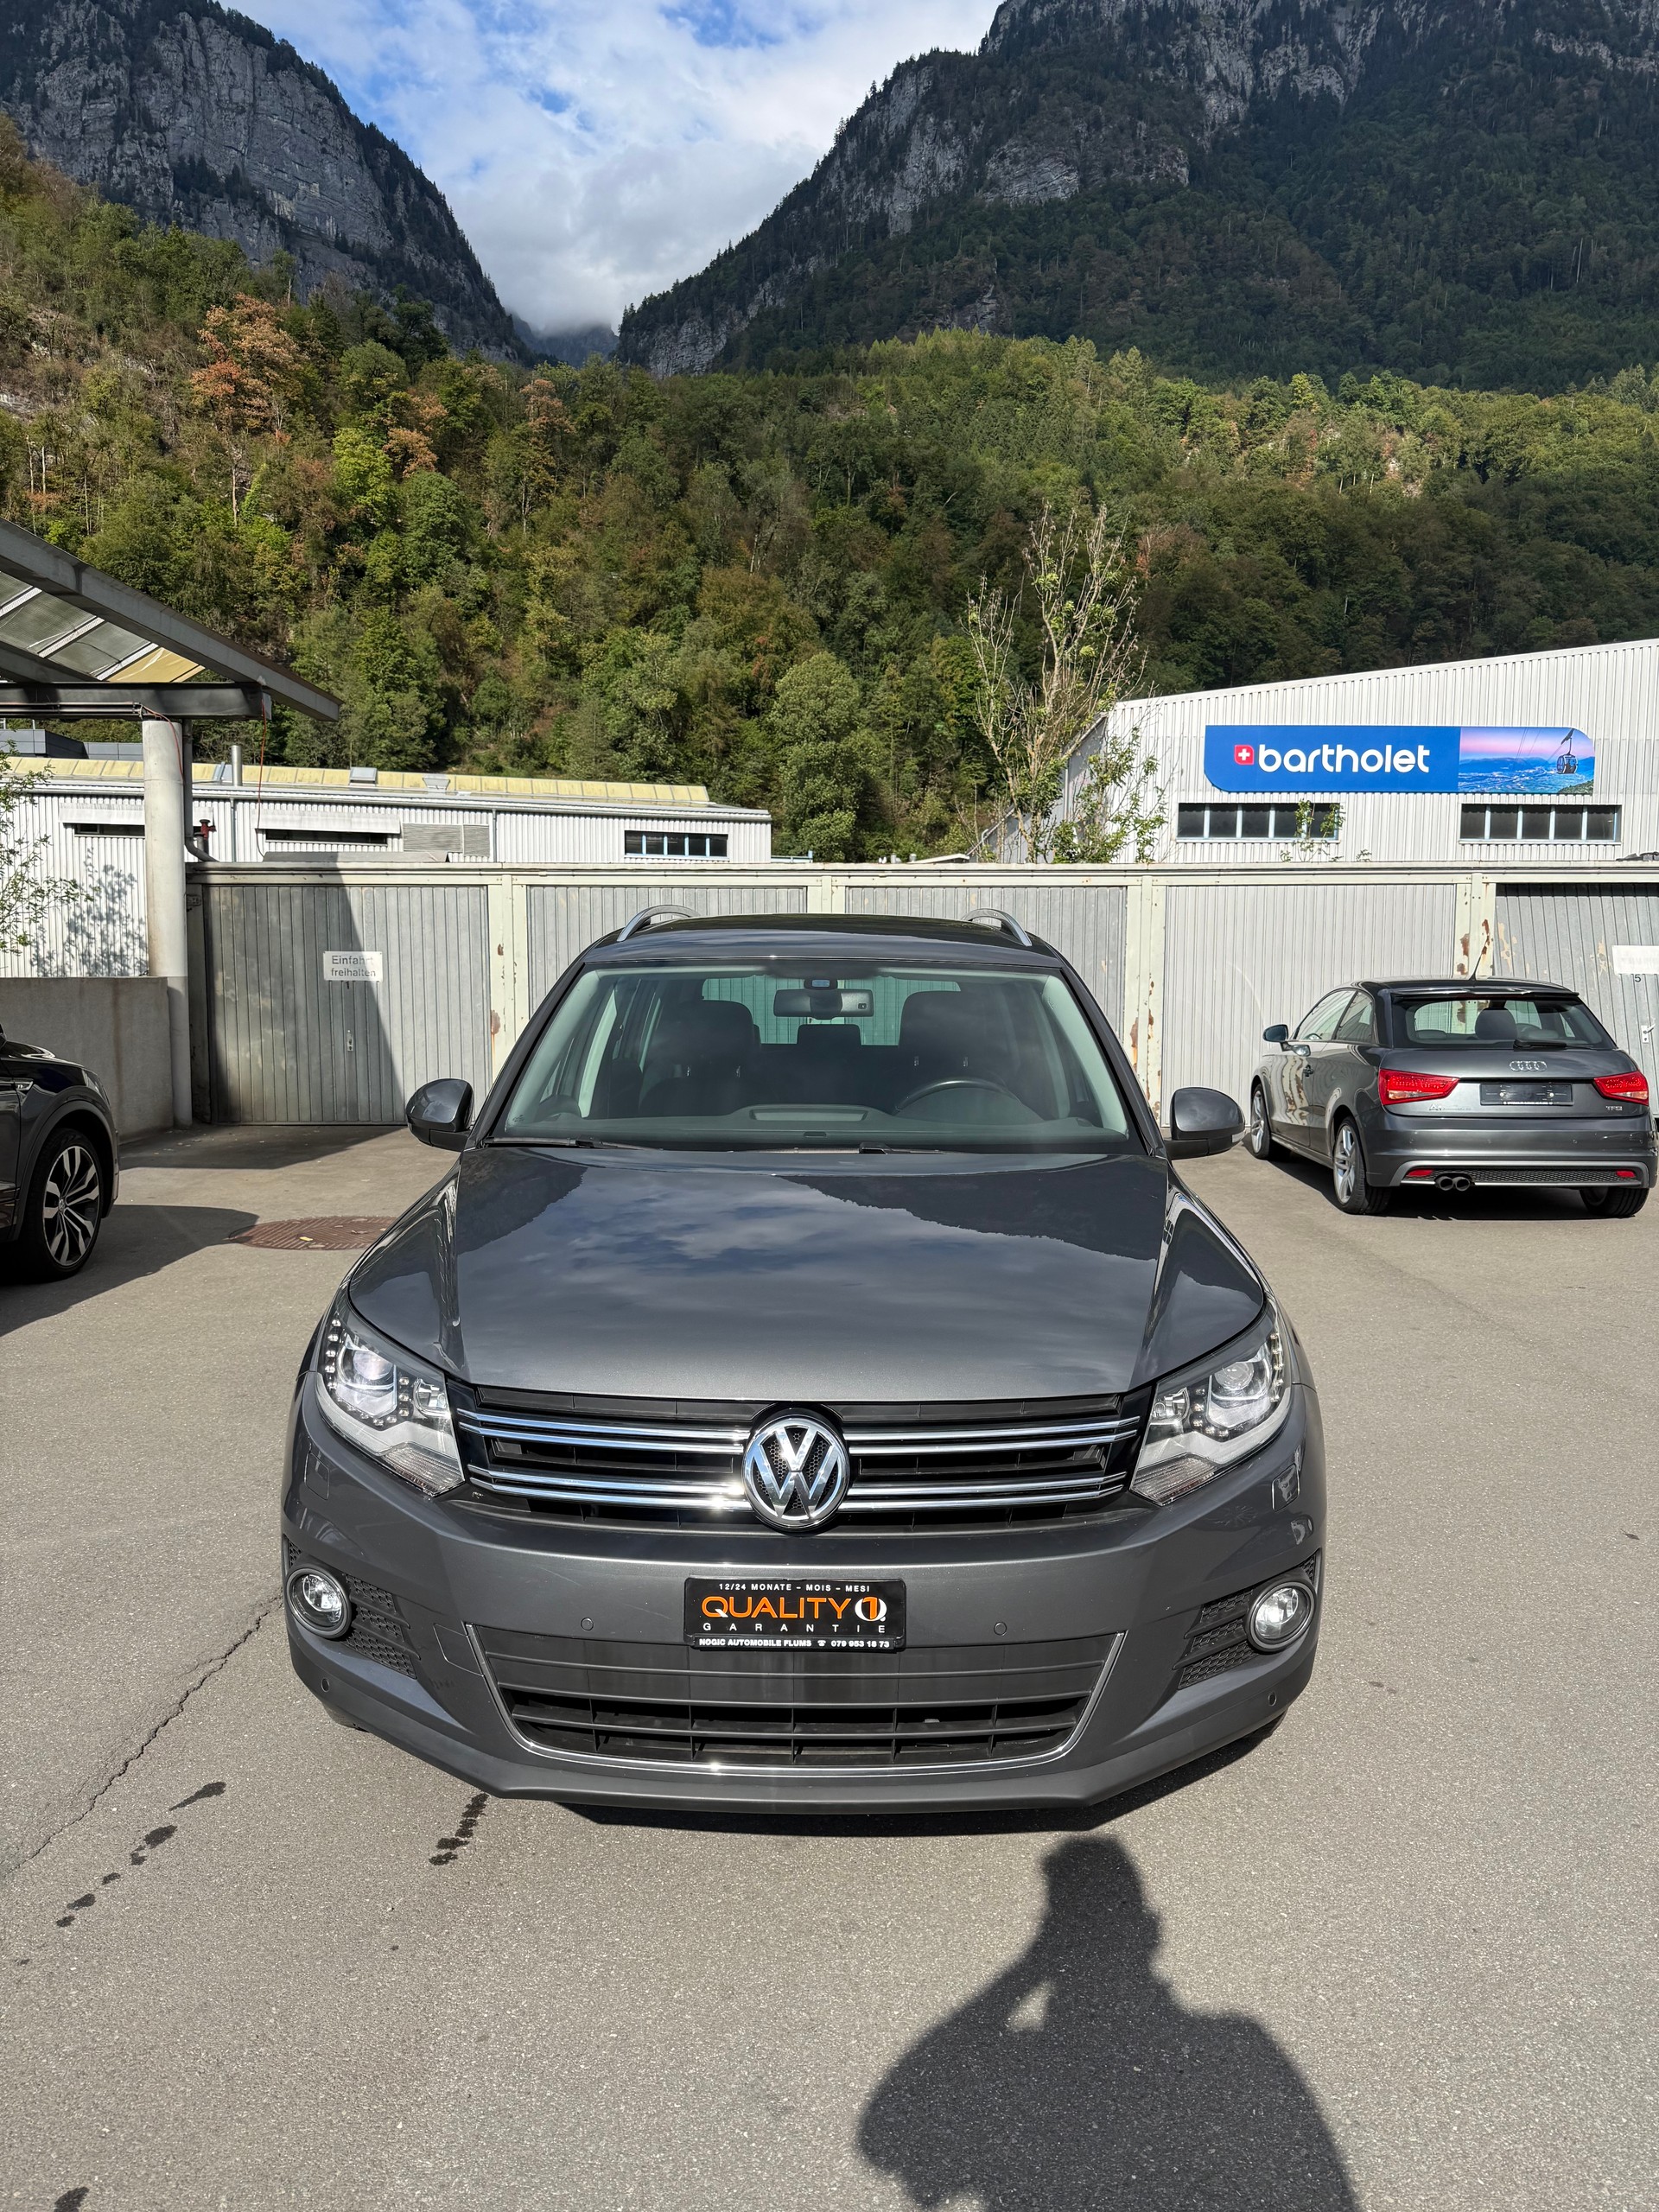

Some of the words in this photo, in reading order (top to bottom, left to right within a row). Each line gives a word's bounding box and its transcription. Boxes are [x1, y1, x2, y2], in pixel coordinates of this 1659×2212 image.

[1258, 743, 1430, 773] bartholet
[331, 968, 376, 976] freihalten
[1634, 974, 1642, 982] 5
[751, 1583, 791, 1592] MONATE
[702, 1623, 886, 1634] GARANTIE
[727, 1638, 782, 1647] AUTOMOBILE
